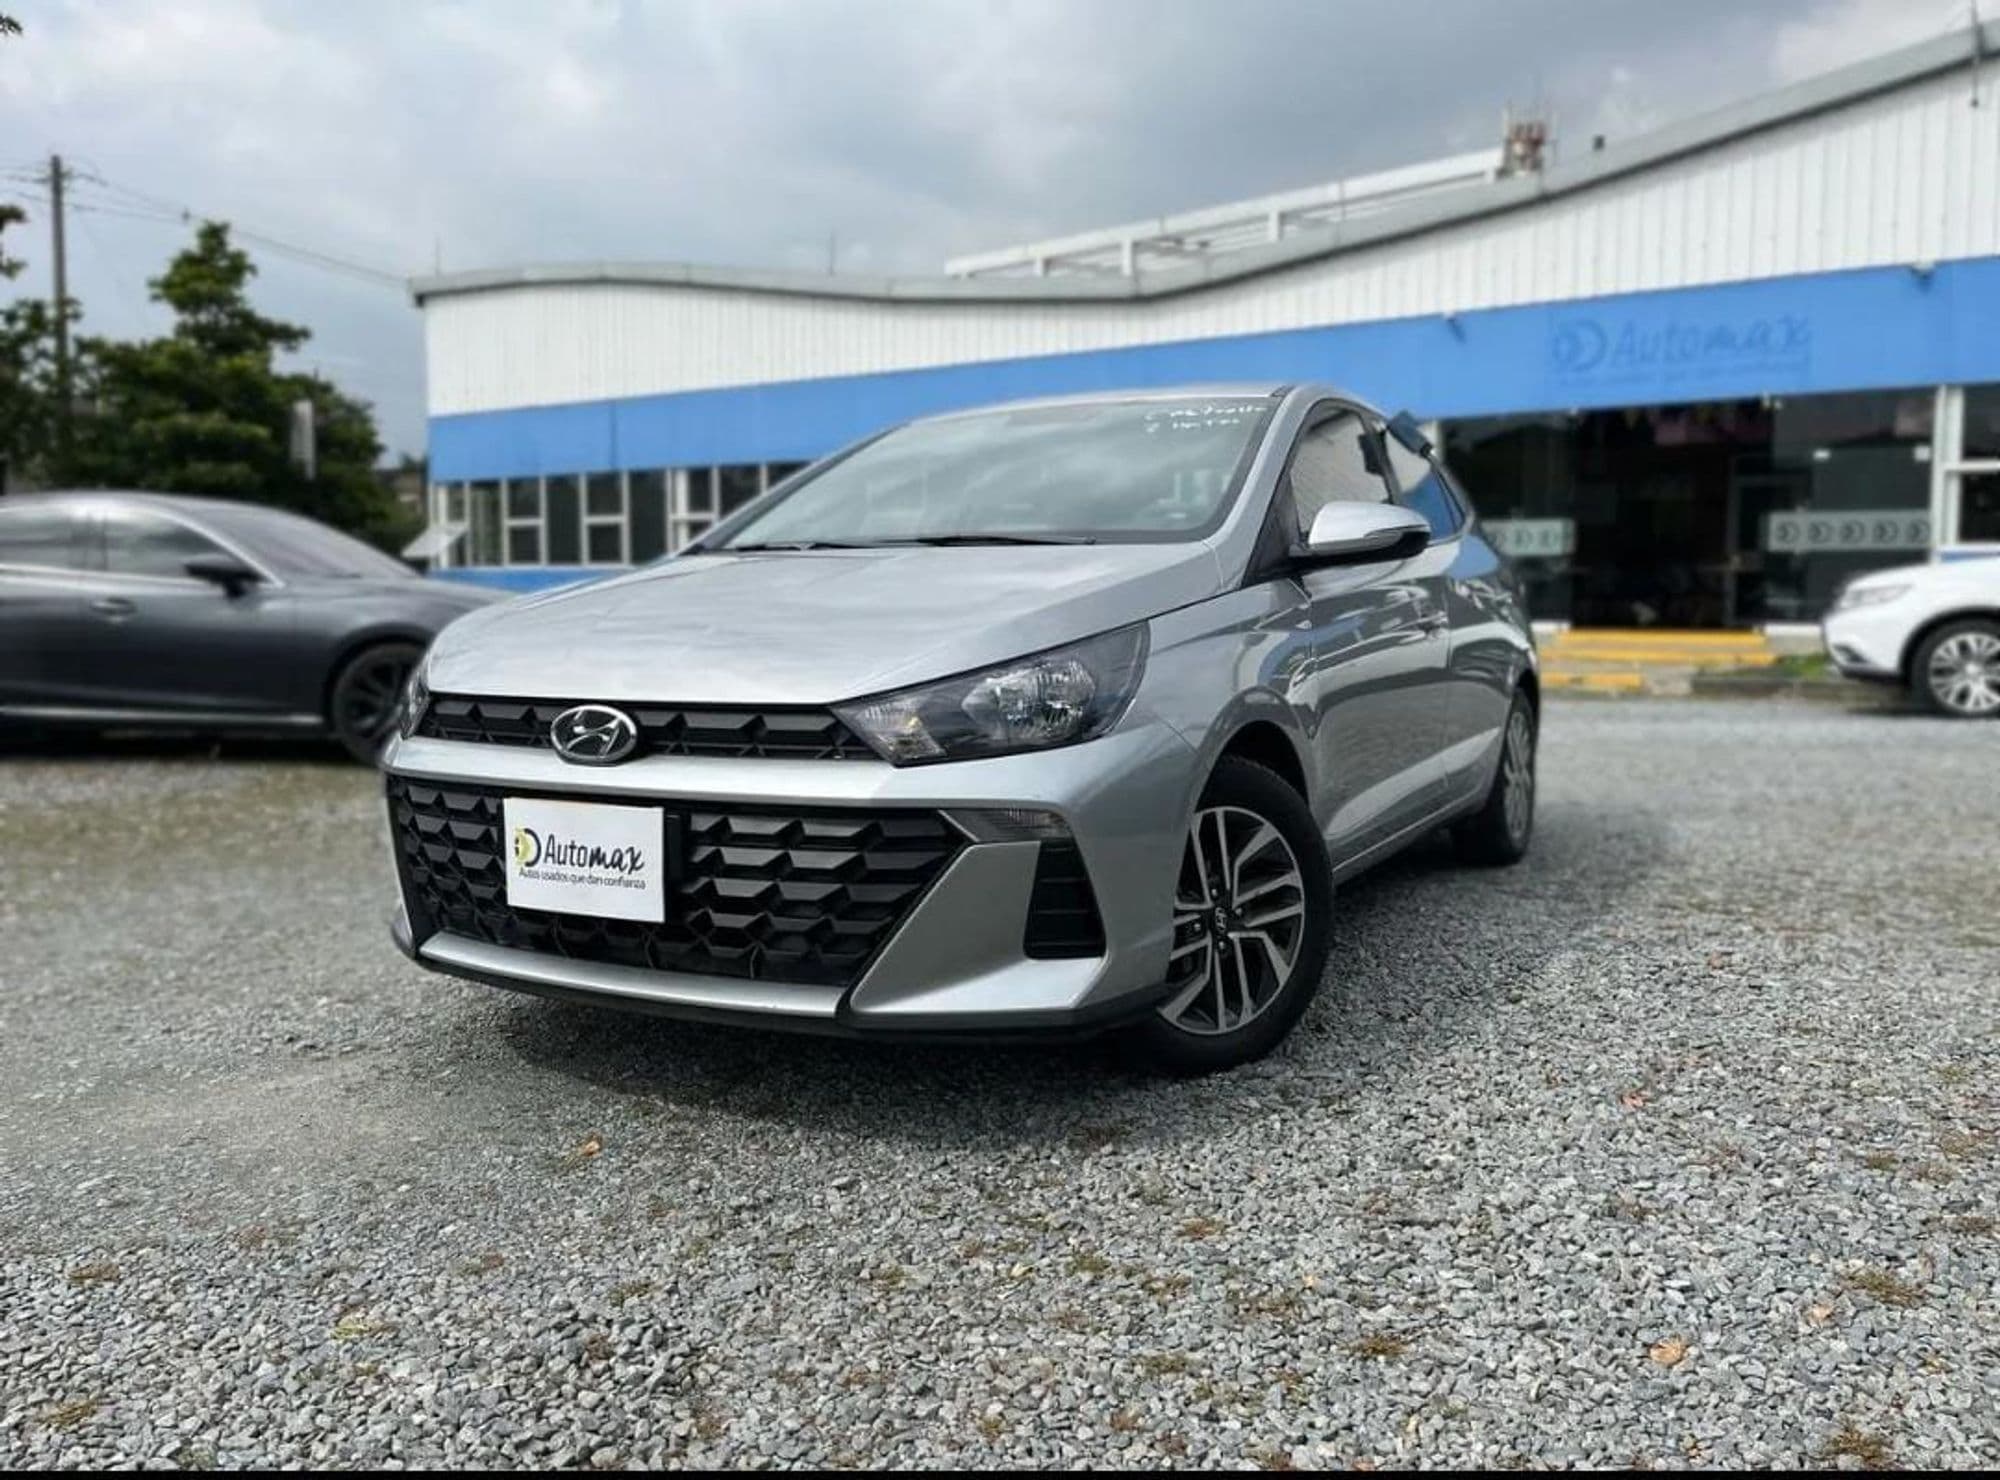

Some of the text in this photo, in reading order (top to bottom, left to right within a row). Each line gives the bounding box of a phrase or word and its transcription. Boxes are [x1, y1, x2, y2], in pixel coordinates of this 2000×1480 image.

[1612, 313, 1810, 364] Automax
[543, 833, 645, 875] Automax
[519, 867, 646, 890] Autos usados que dan confianza
